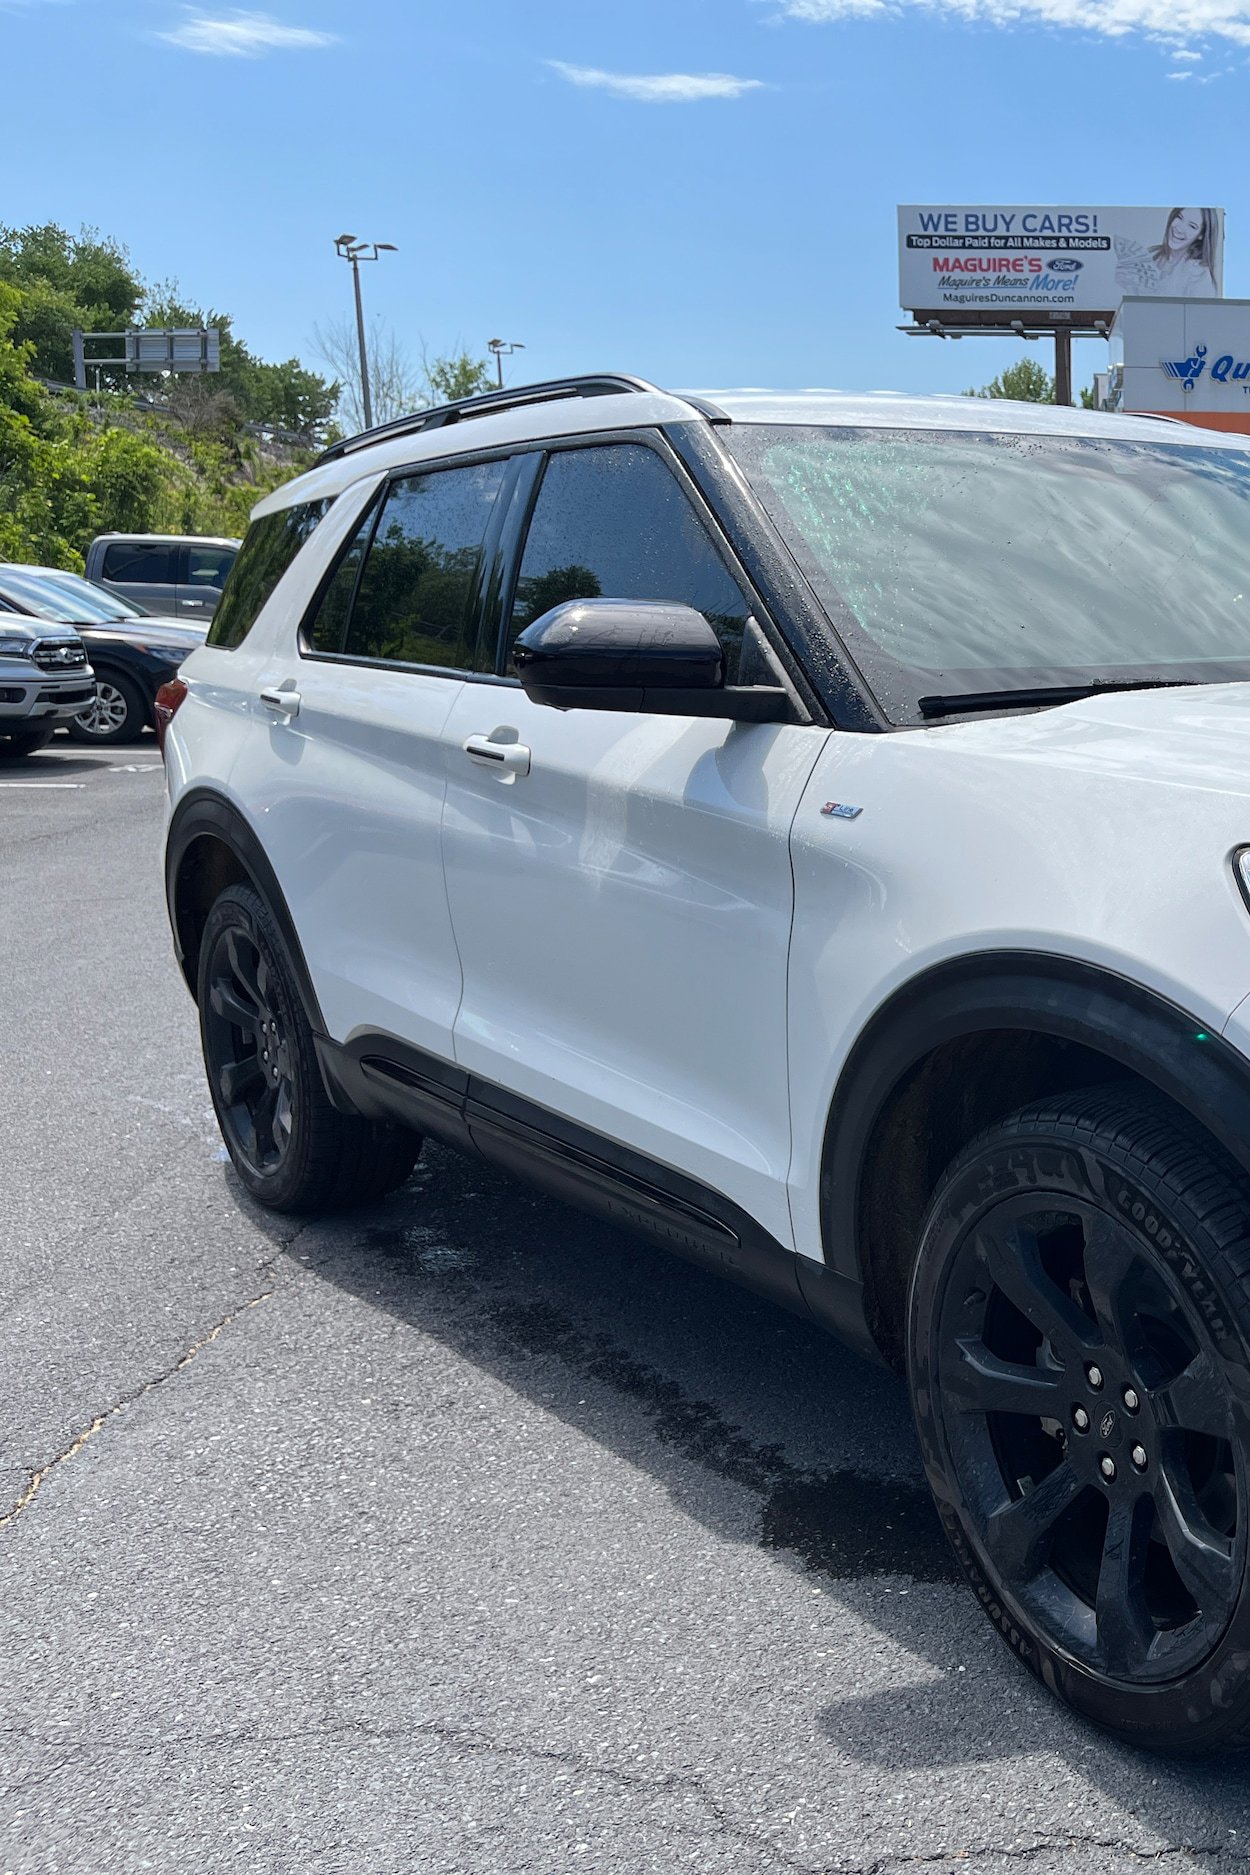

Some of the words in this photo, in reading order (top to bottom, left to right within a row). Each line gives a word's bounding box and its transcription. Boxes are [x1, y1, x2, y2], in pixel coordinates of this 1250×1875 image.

[918, 213, 958, 232] WE
[964, 213, 1016, 233] BUY
[1021, 213, 1098, 234] CARS!
[910, 236, 930, 248] Top
[932, 236, 963, 247] Dollar
[965, 237, 989, 247] Paid
[990, 237, 1006, 247] for
[1006, 237, 1021, 248] All
[1022, 238, 1057, 248] Makes
[1058, 238, 1067, 248] &
[1069, 238, 1108, 249] Models
[932, 255, 1043, 273] MAGUIRE'S
[938, 275, 991, 290] Maguire's
[992, 277, 1030, 287] Means
[1029, 274, 1080, 291] More!
[943, 293, 1075, 304] MaguiresDuncannon.com
